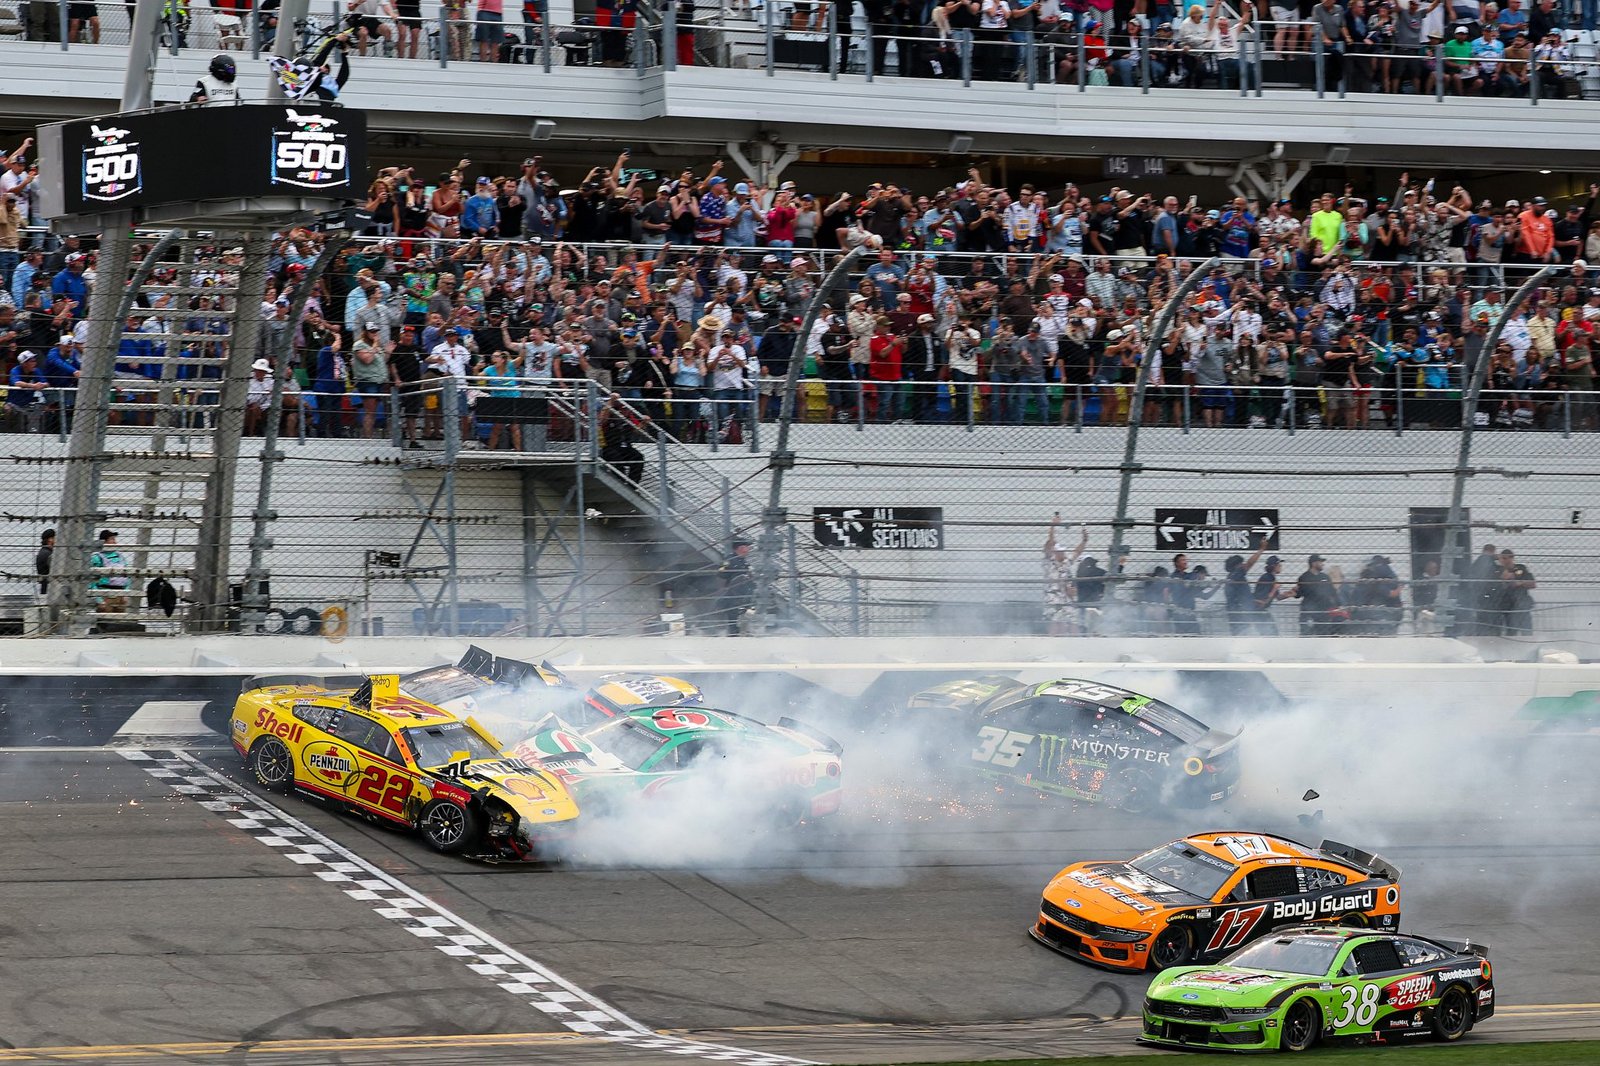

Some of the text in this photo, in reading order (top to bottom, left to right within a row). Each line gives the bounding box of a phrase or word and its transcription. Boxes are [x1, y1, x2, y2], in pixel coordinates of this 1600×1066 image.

[277, 142, 346, 170] 500
[1108, 157, 1129, 173] 145
[1143, 158, 1164, 174] 144
[85, 153, 139, 184] 500
[872, 508, 898, 528] ALL
[1206, 510, 1228, 529] ALL
[872, 528, 939, 548] SECTIONS
[1186, 529, 1250, 549] SECTIONS
[254, 707, 306, 744] Shell
[972, 725, 1035, 768] 35
[309, 753, 353, 774] PENNZOIL
[356, 765, 414, 814] 22
[1198, 854, 1236, 872] BUESCHER
[1273, 889, 1374, 920] Body Guard
[1166, 913, 1195, 922] GOODYEAR
[1204, 903, 1269, 953] 17
[1396, 975, 1435, 996] SPEEDY
[1333, 982, 1380, 1029] 38
